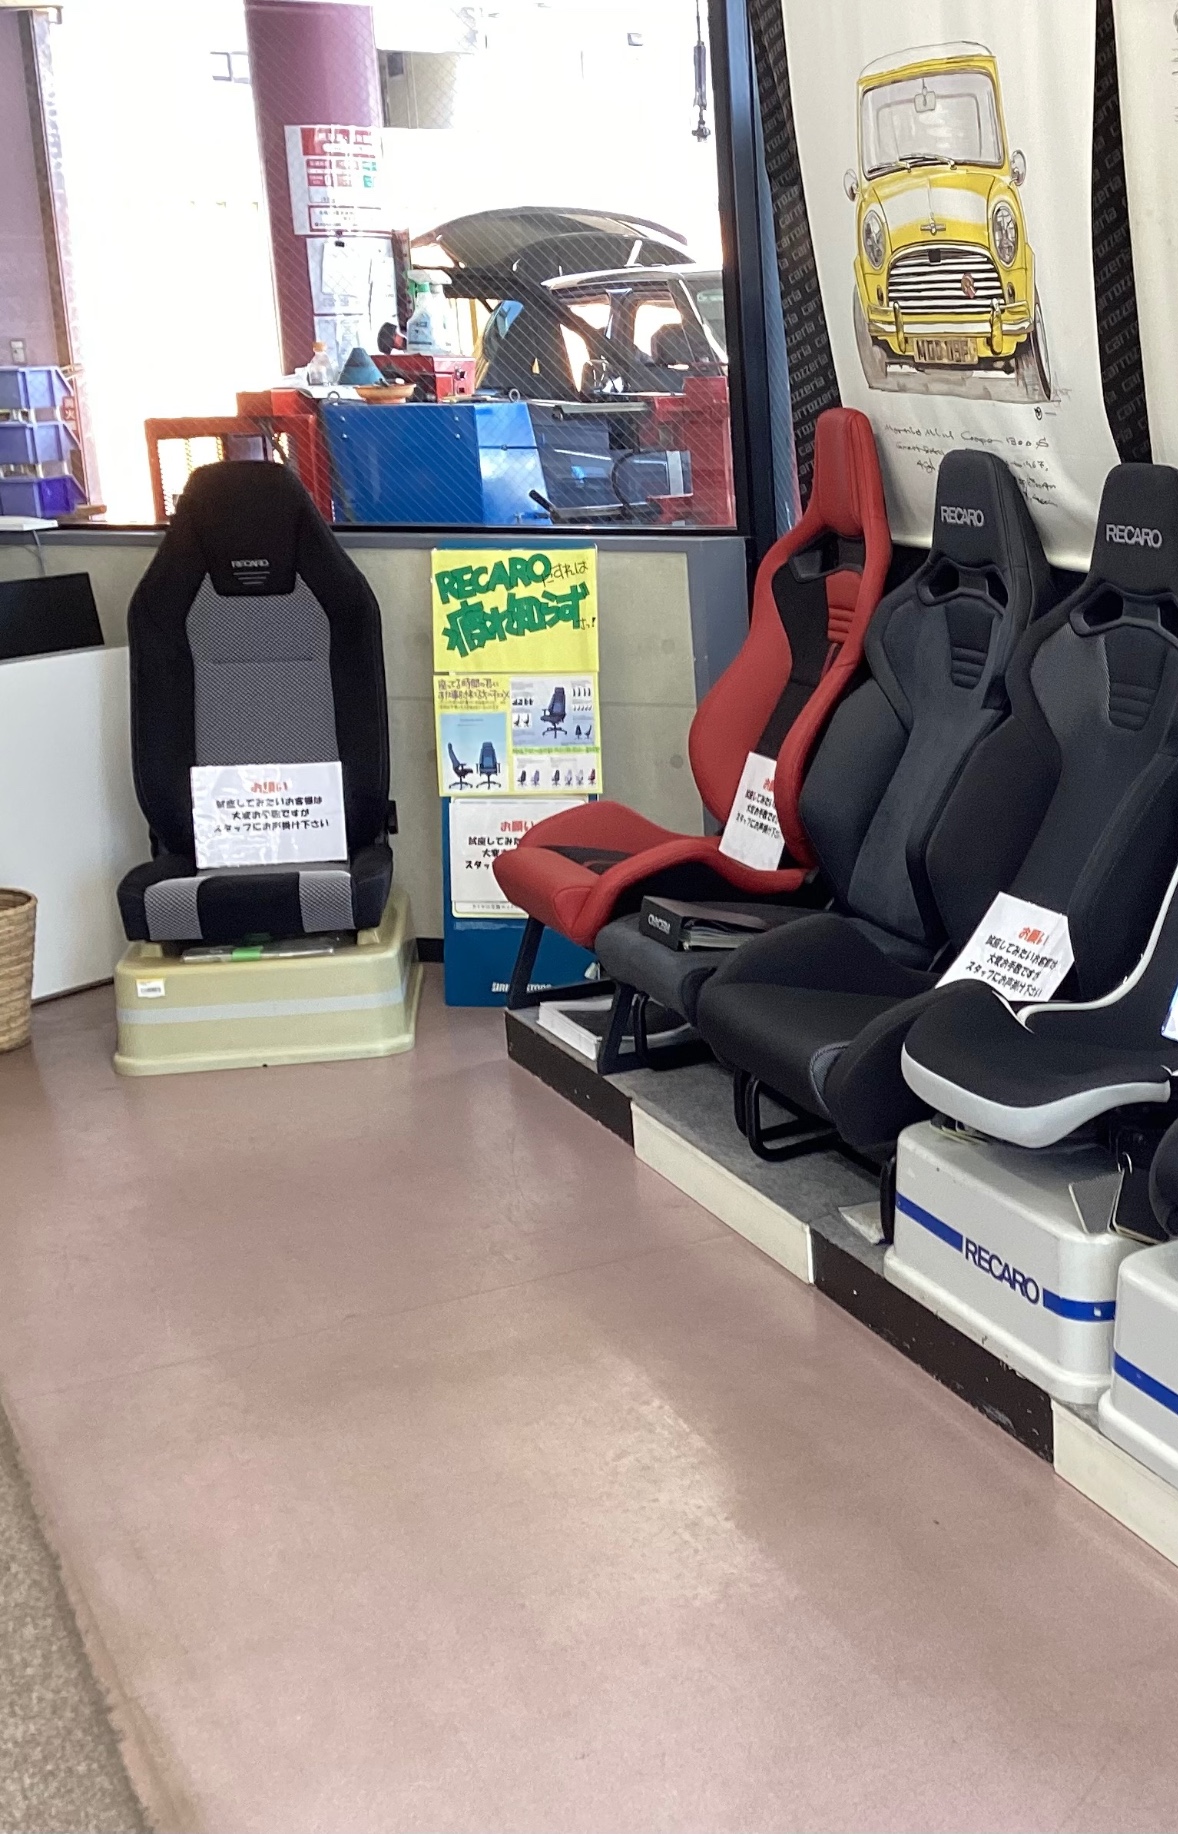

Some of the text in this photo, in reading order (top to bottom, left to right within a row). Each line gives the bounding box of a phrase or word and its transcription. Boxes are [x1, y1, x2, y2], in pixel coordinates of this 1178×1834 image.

[940, 505, 985, 528] RECARO
[1105, 523, 1163, 549] RECARO
[435, 553, 552, 605] RECARO
[1018, 926, 1050, 946] お願い
[965, 1237, 1040, 1305] RECARO
